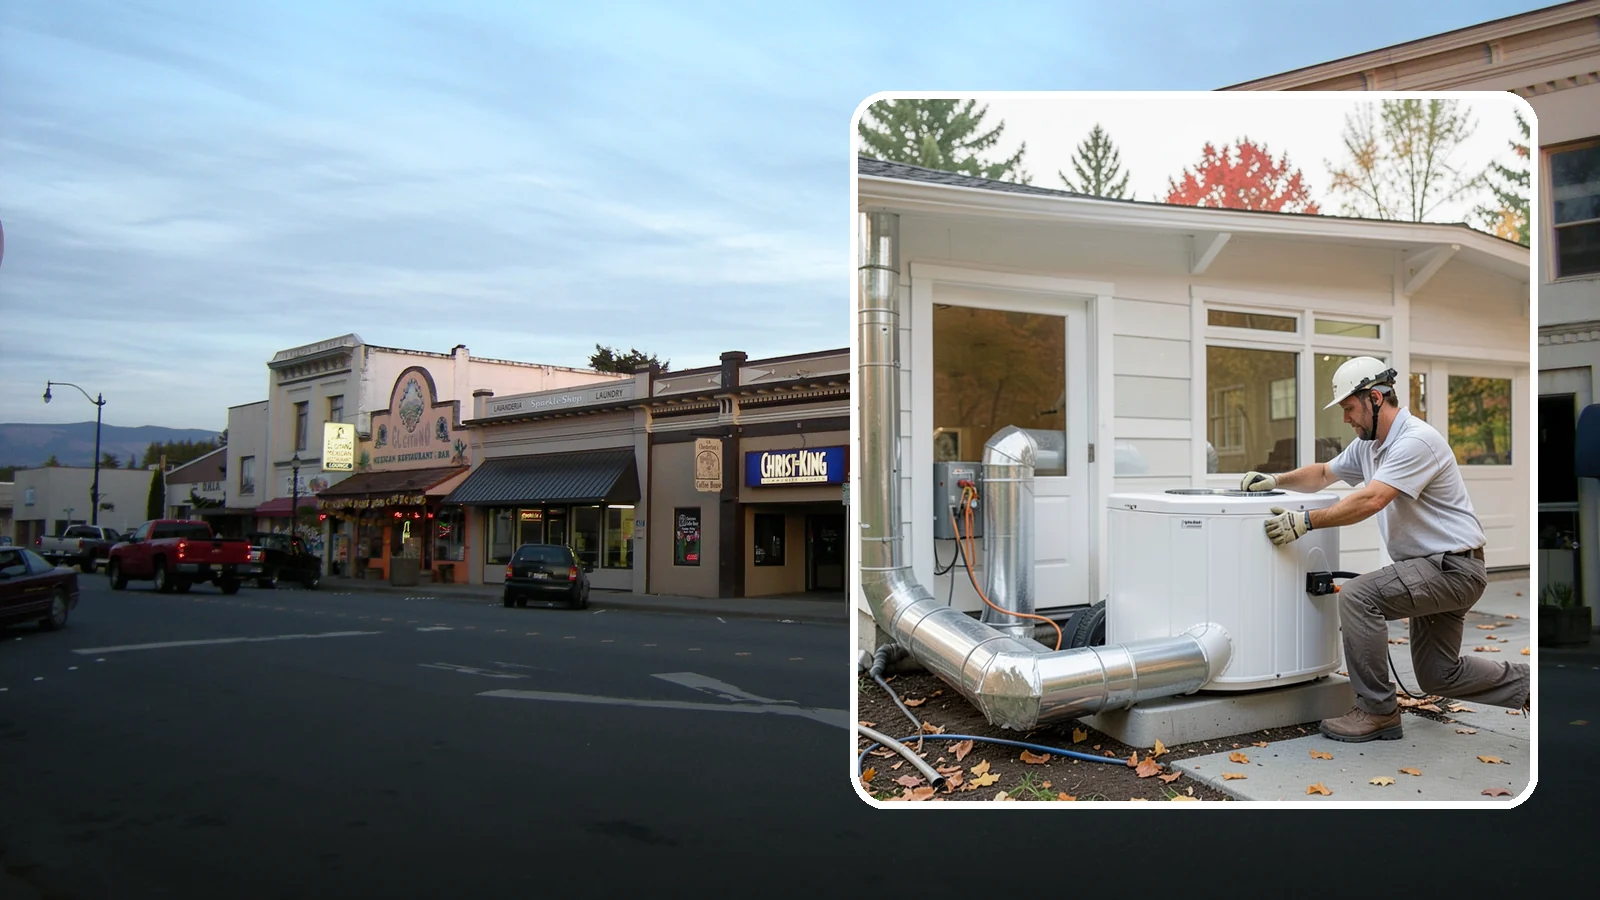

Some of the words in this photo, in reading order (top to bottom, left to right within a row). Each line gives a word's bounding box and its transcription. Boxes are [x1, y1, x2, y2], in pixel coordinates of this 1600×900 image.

[595, 389, 624, 400] LAUNDRY
[493, 402, 523, 413] LAVANDERIA
[531, 397, 561, 410] Sparkle
[561, 394, 582, 406] Shop
[374, 454, 397, 464] MEXICAN
[398, 452, 433, 462] RESTAURANT
[438, 450, 450, 459] BAR
[761, 452, 797, 478] CHRIST
[799, 450, 828, 477] KING
